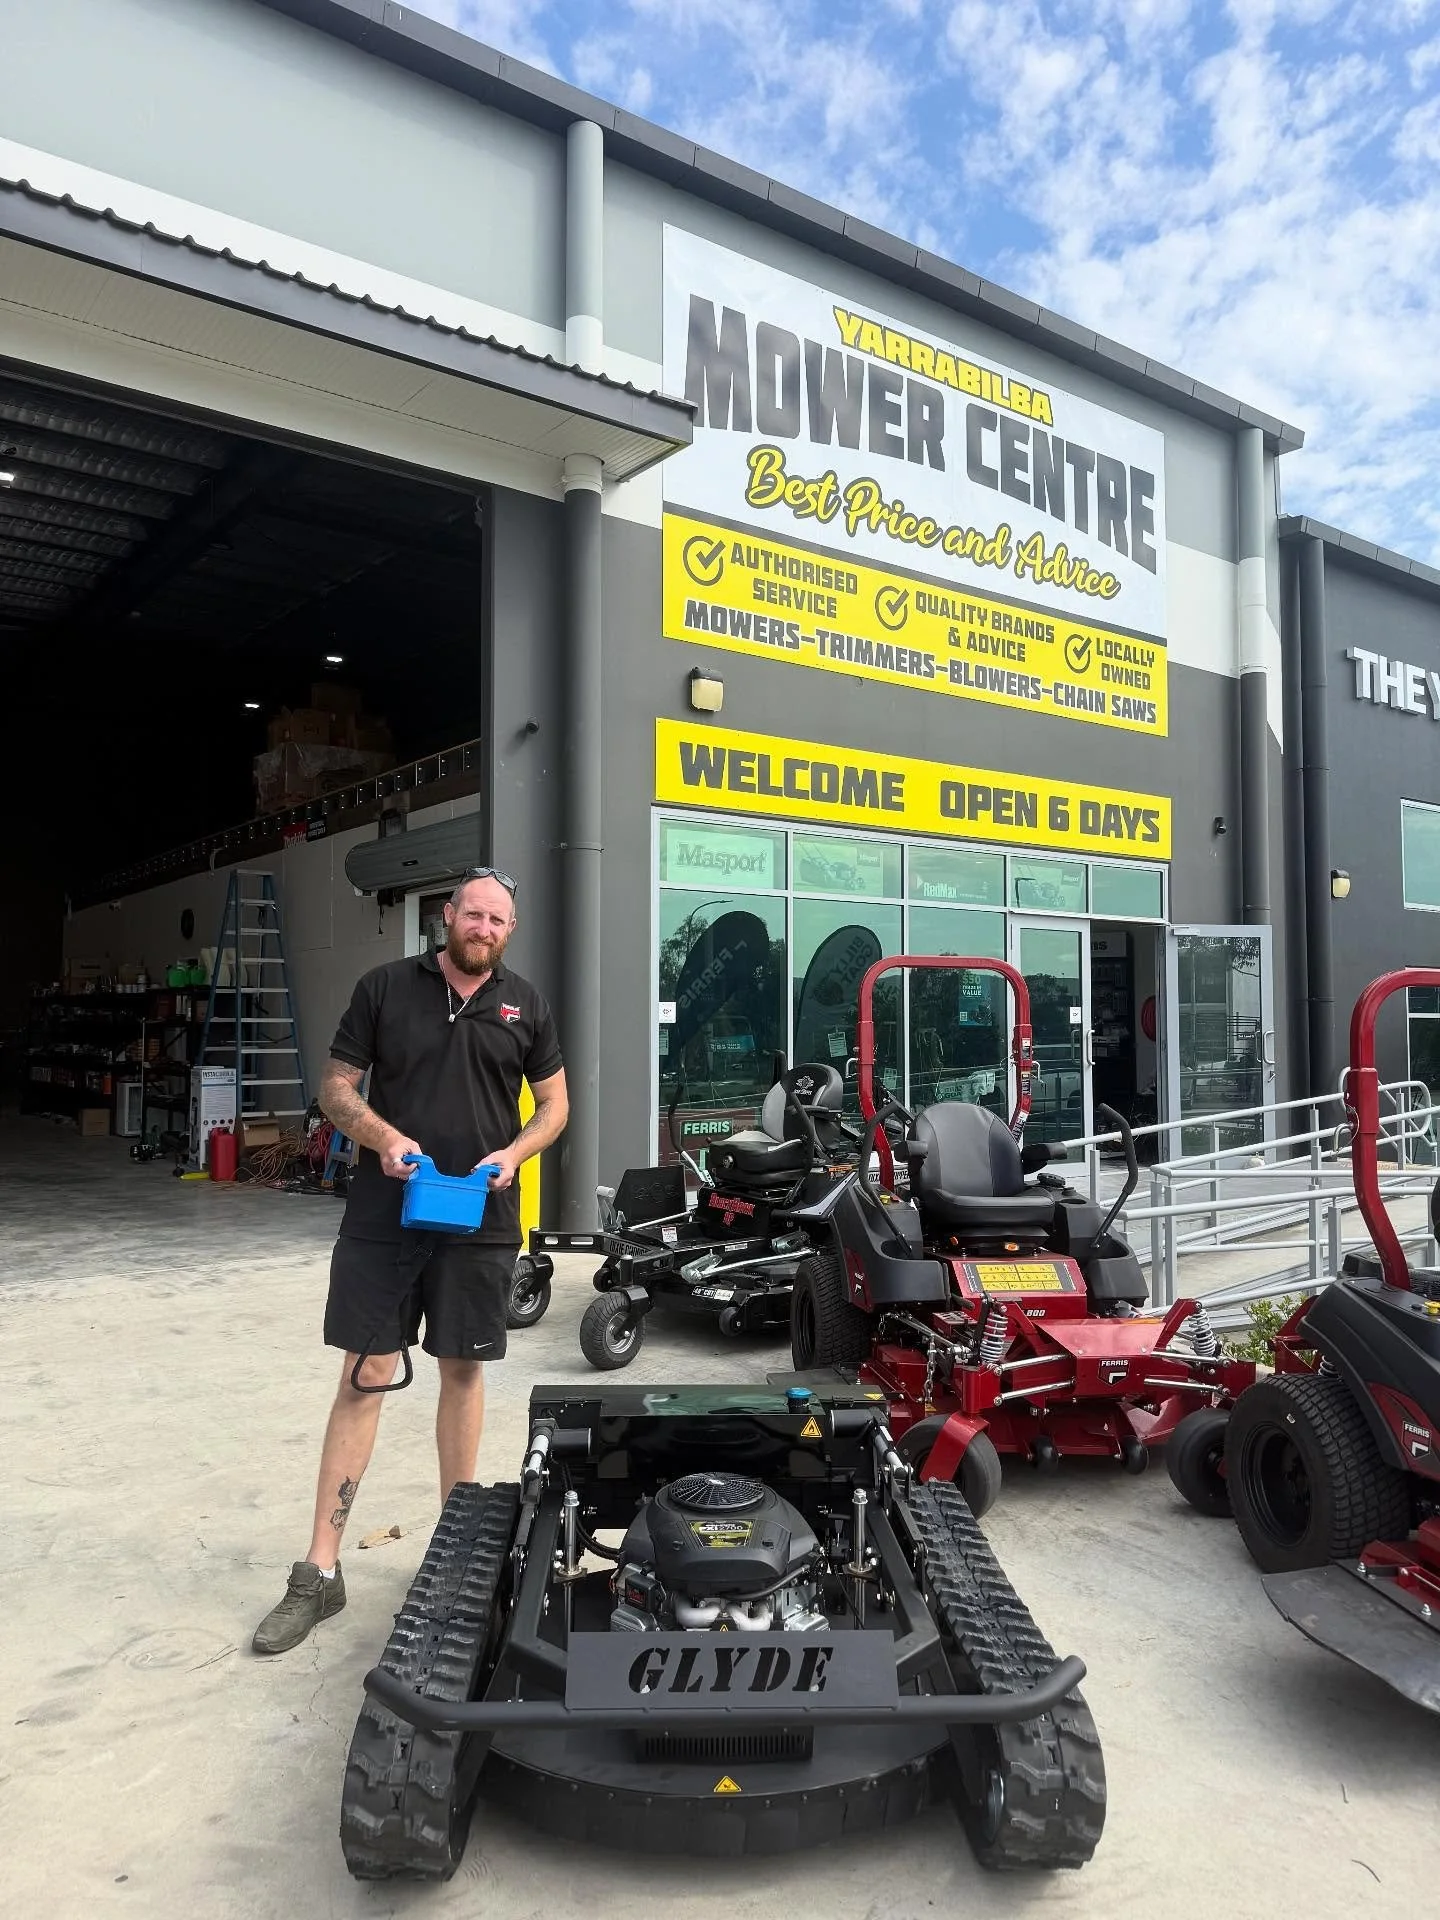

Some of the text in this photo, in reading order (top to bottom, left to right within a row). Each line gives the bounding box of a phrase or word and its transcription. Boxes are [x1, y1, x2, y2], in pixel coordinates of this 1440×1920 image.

[833, 305, 1053, 427] YARRABILBA
[684, 294, 1157, 576] MOWER CENTRE
[745, 445, 1121, 600] Best Price and Advice
[731, 543, 858, 595] AUTHORISED
[753, 578, 837, 618] SERVICE
[915, 590, 1055, 644] QUALITY BRANDS
[948, 626, 1026, 662] & ADVICE
[1096, 637, 1155, 668] LOCALLY
[1101, 663, 1151, 690] OWNED
[1111, 696, 1157, 724] SAWS
[679, 741, 1160, 843] WELCOME OPEN 6 DAYS
[677, 841, 767, 874] Masport
[923, 882, 957, 898] RedMax
[683, 1121, 730, 1135] FERRIS
[1026, 1309, 1046, 1317] 800
[1101, 1359, 1129, 1368] FERRIS
[1404, 1423, 1430, 1438] FERRIS
[628, 1646, 834, 1694] GLYDE
